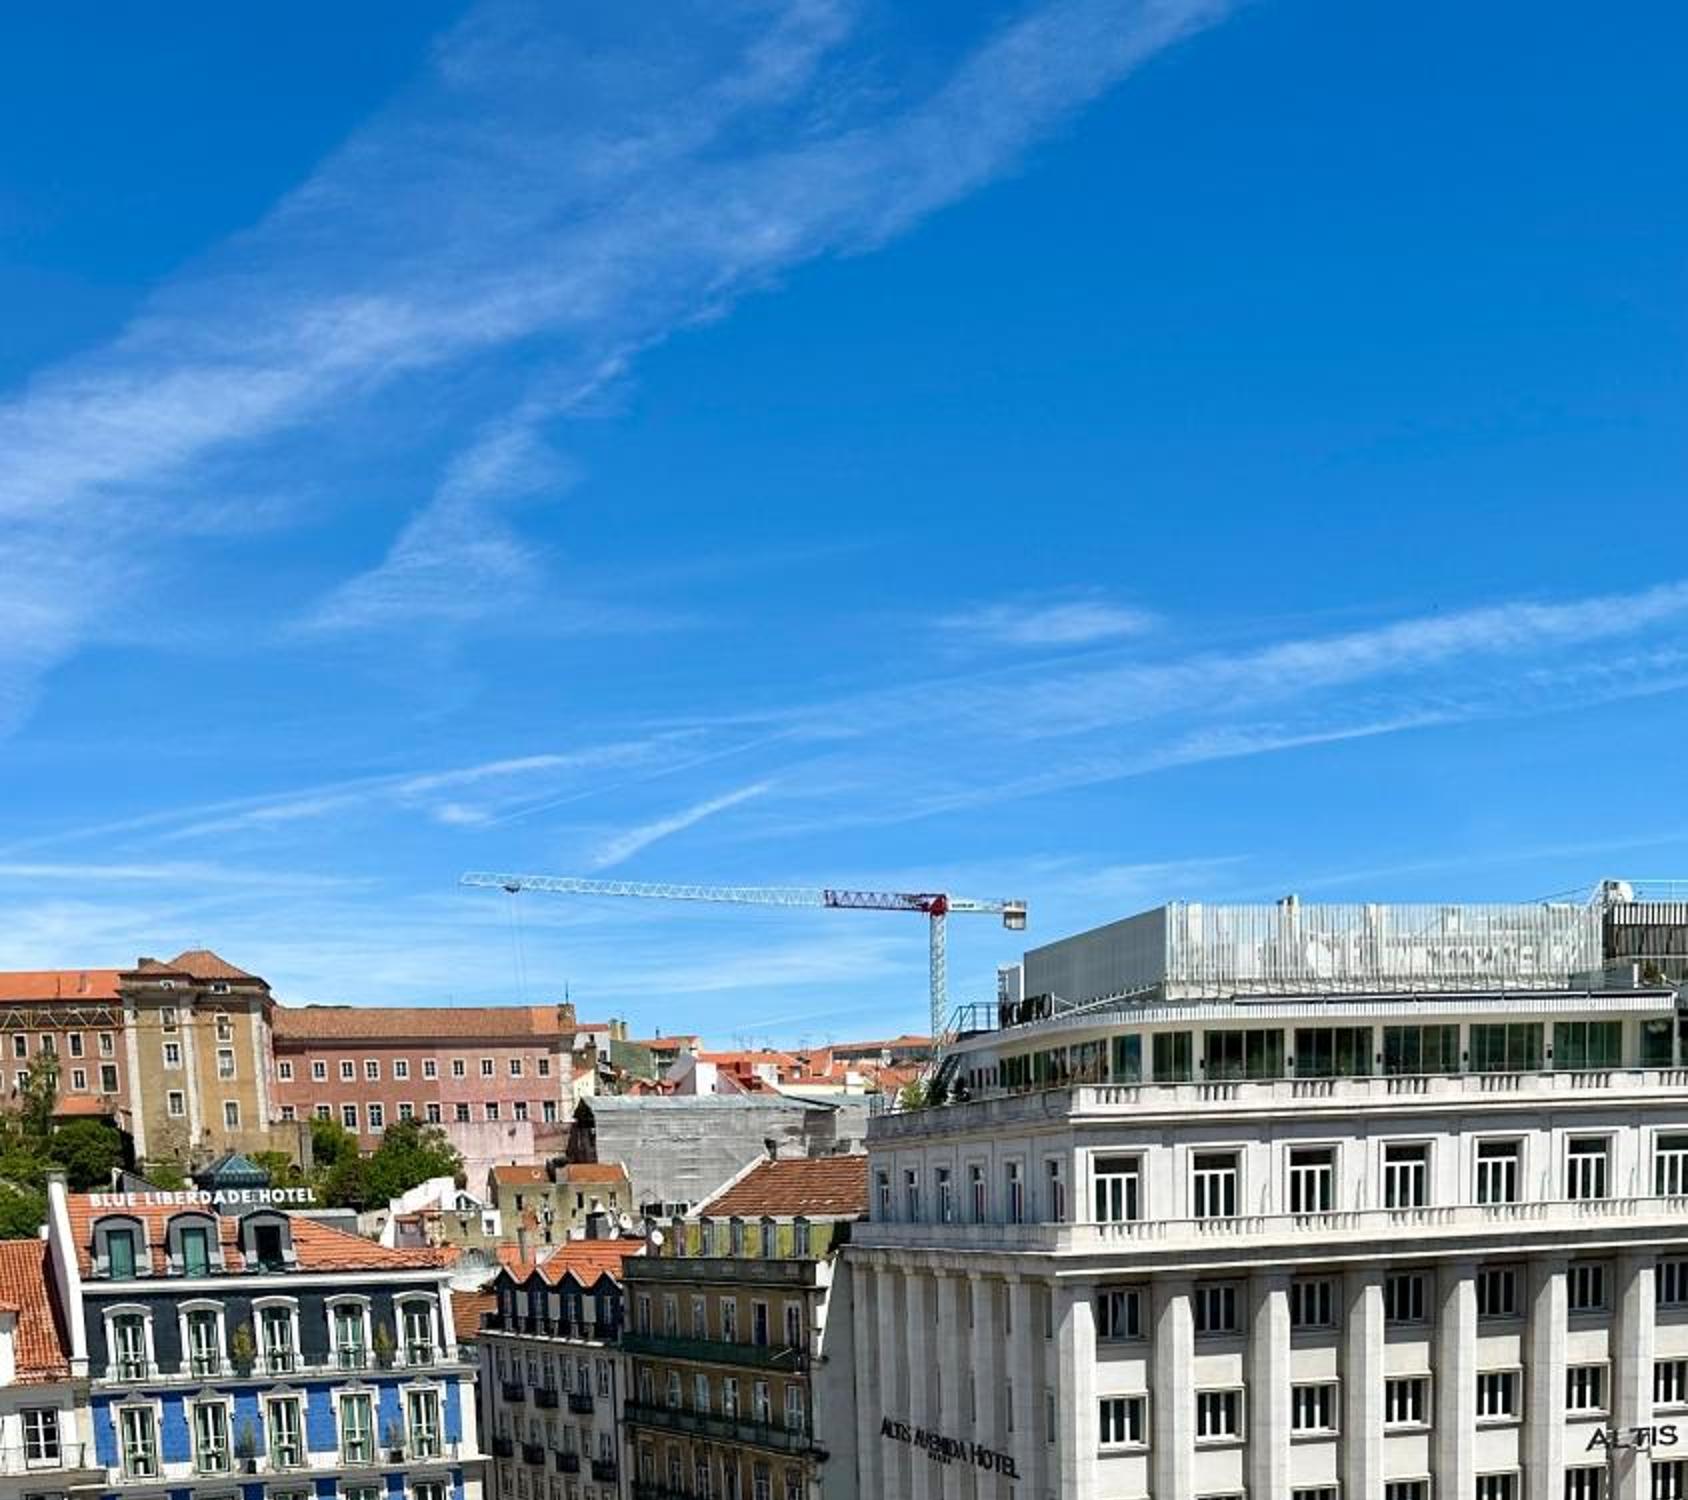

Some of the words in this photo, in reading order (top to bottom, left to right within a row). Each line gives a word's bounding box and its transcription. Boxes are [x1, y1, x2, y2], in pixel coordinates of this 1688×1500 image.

[88, 1193, 137, 1207] BLUE
[144, 1190, 252, 1206] LIBERDADE
[259, 1187, 317, 1203] HOTEL
[881, 1417, 912, 1443] ALTIS
[970, 1441, 1020, 1480] HOTEL
[1585, 1425, 1679, 1451] ALTIS
